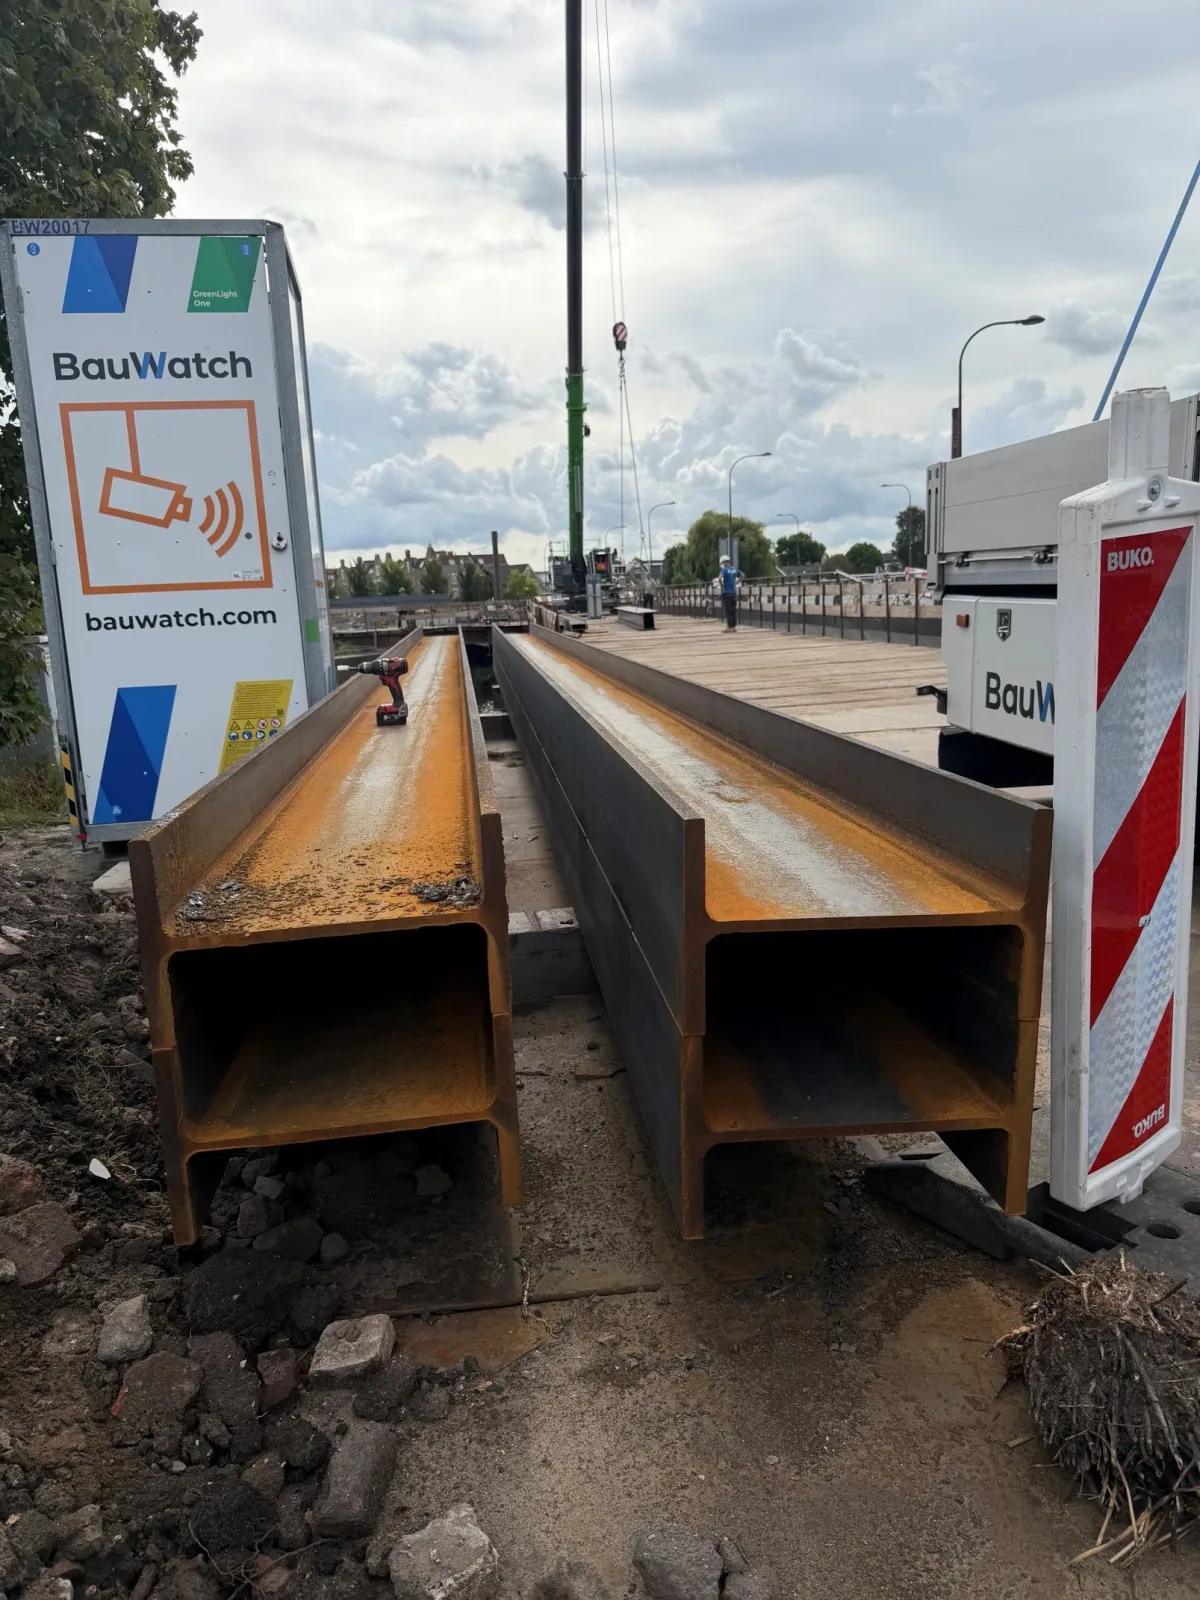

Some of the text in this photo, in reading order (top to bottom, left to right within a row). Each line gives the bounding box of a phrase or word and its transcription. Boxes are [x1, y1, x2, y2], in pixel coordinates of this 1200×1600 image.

[193, 290, 238, 300] GreenLight
[194, 299, 211, 307] One
[53, 351, 252, 380] BauWatch
[86, 608, 276, 631] bauwatch.com
